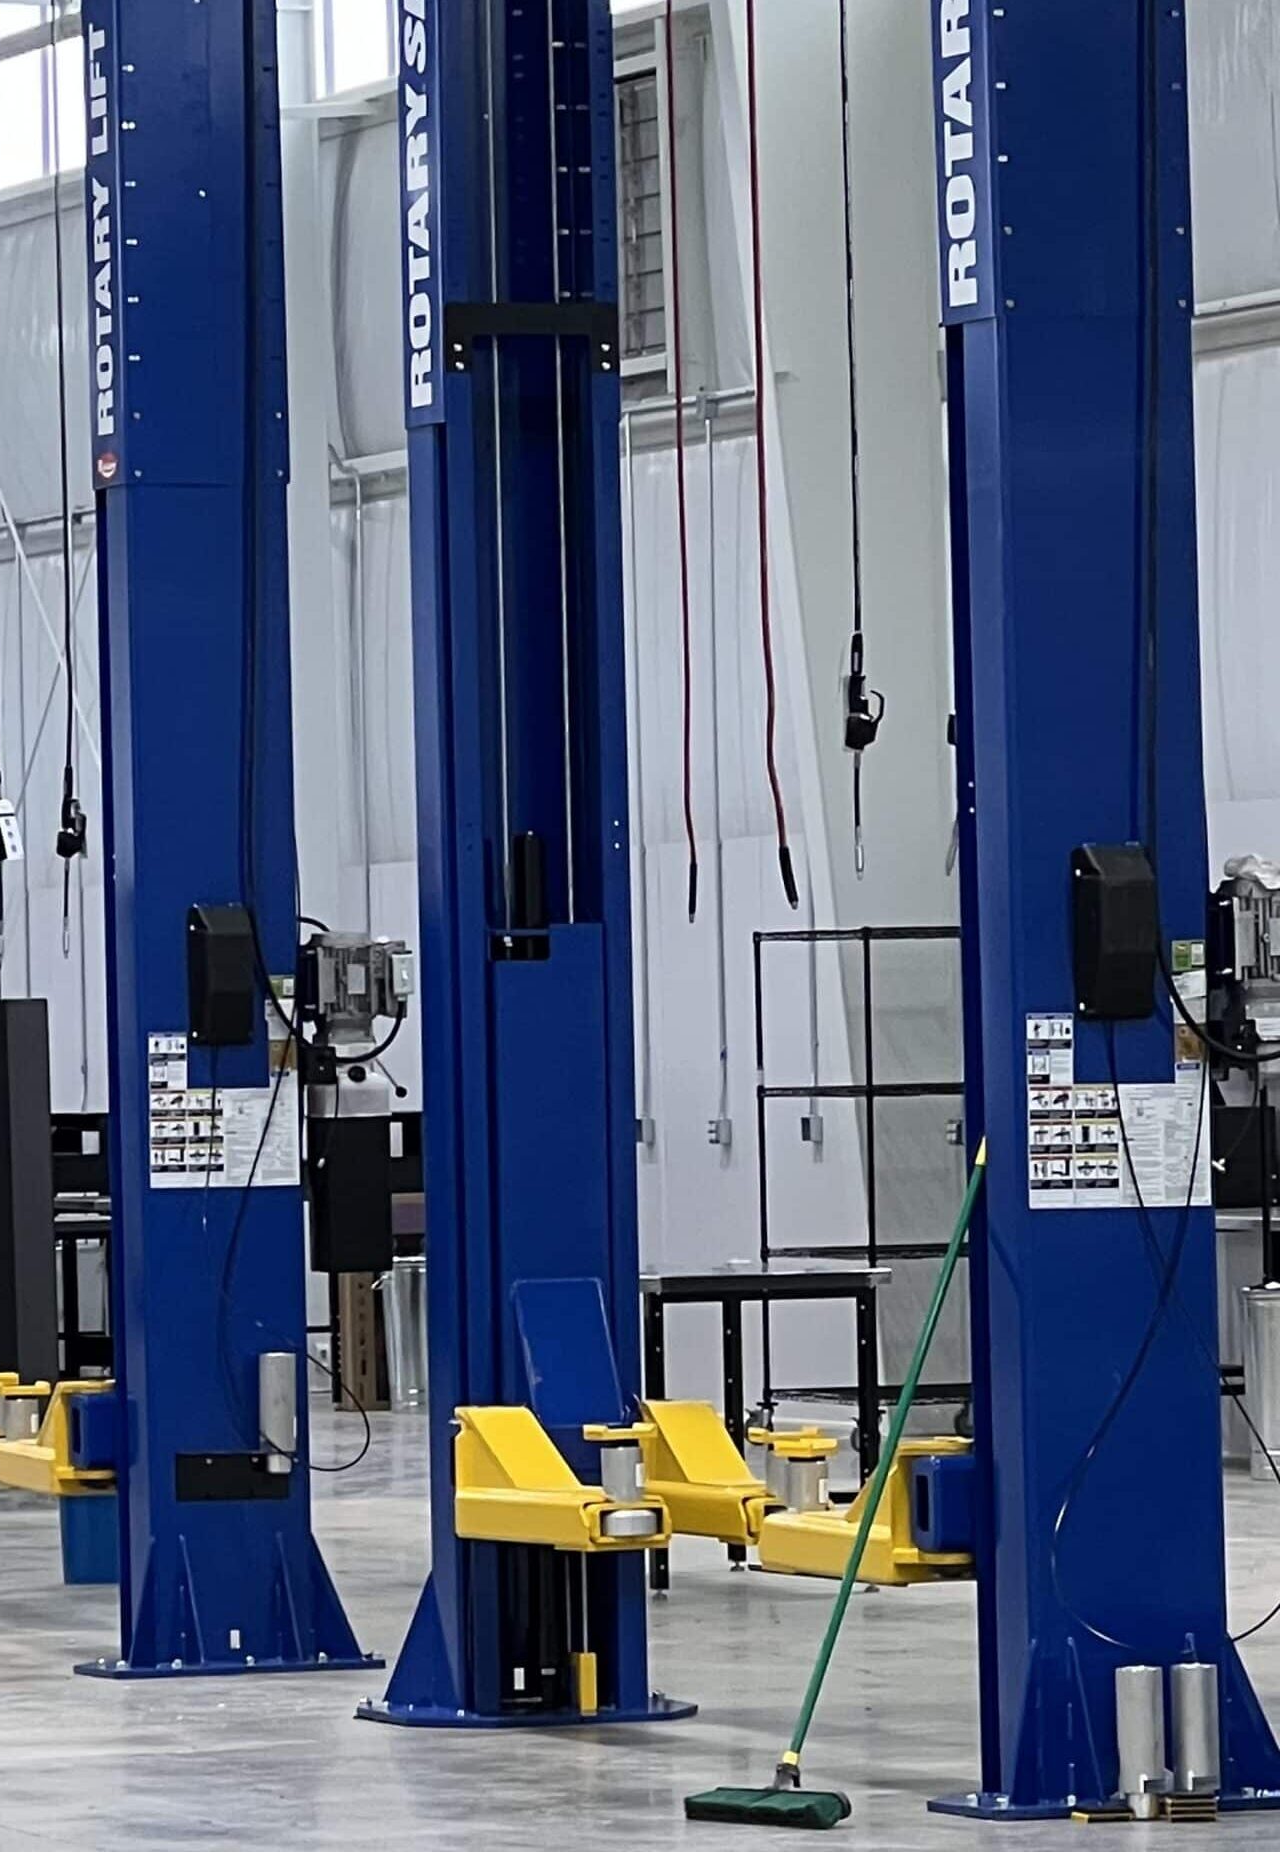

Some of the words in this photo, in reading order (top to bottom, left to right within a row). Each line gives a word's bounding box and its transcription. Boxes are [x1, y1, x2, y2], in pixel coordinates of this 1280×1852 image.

[87, 23, 108, 156] LIFT
[92, 177, 114, 437] ROTARY
[405, 83, 433, 409] ROTARY
